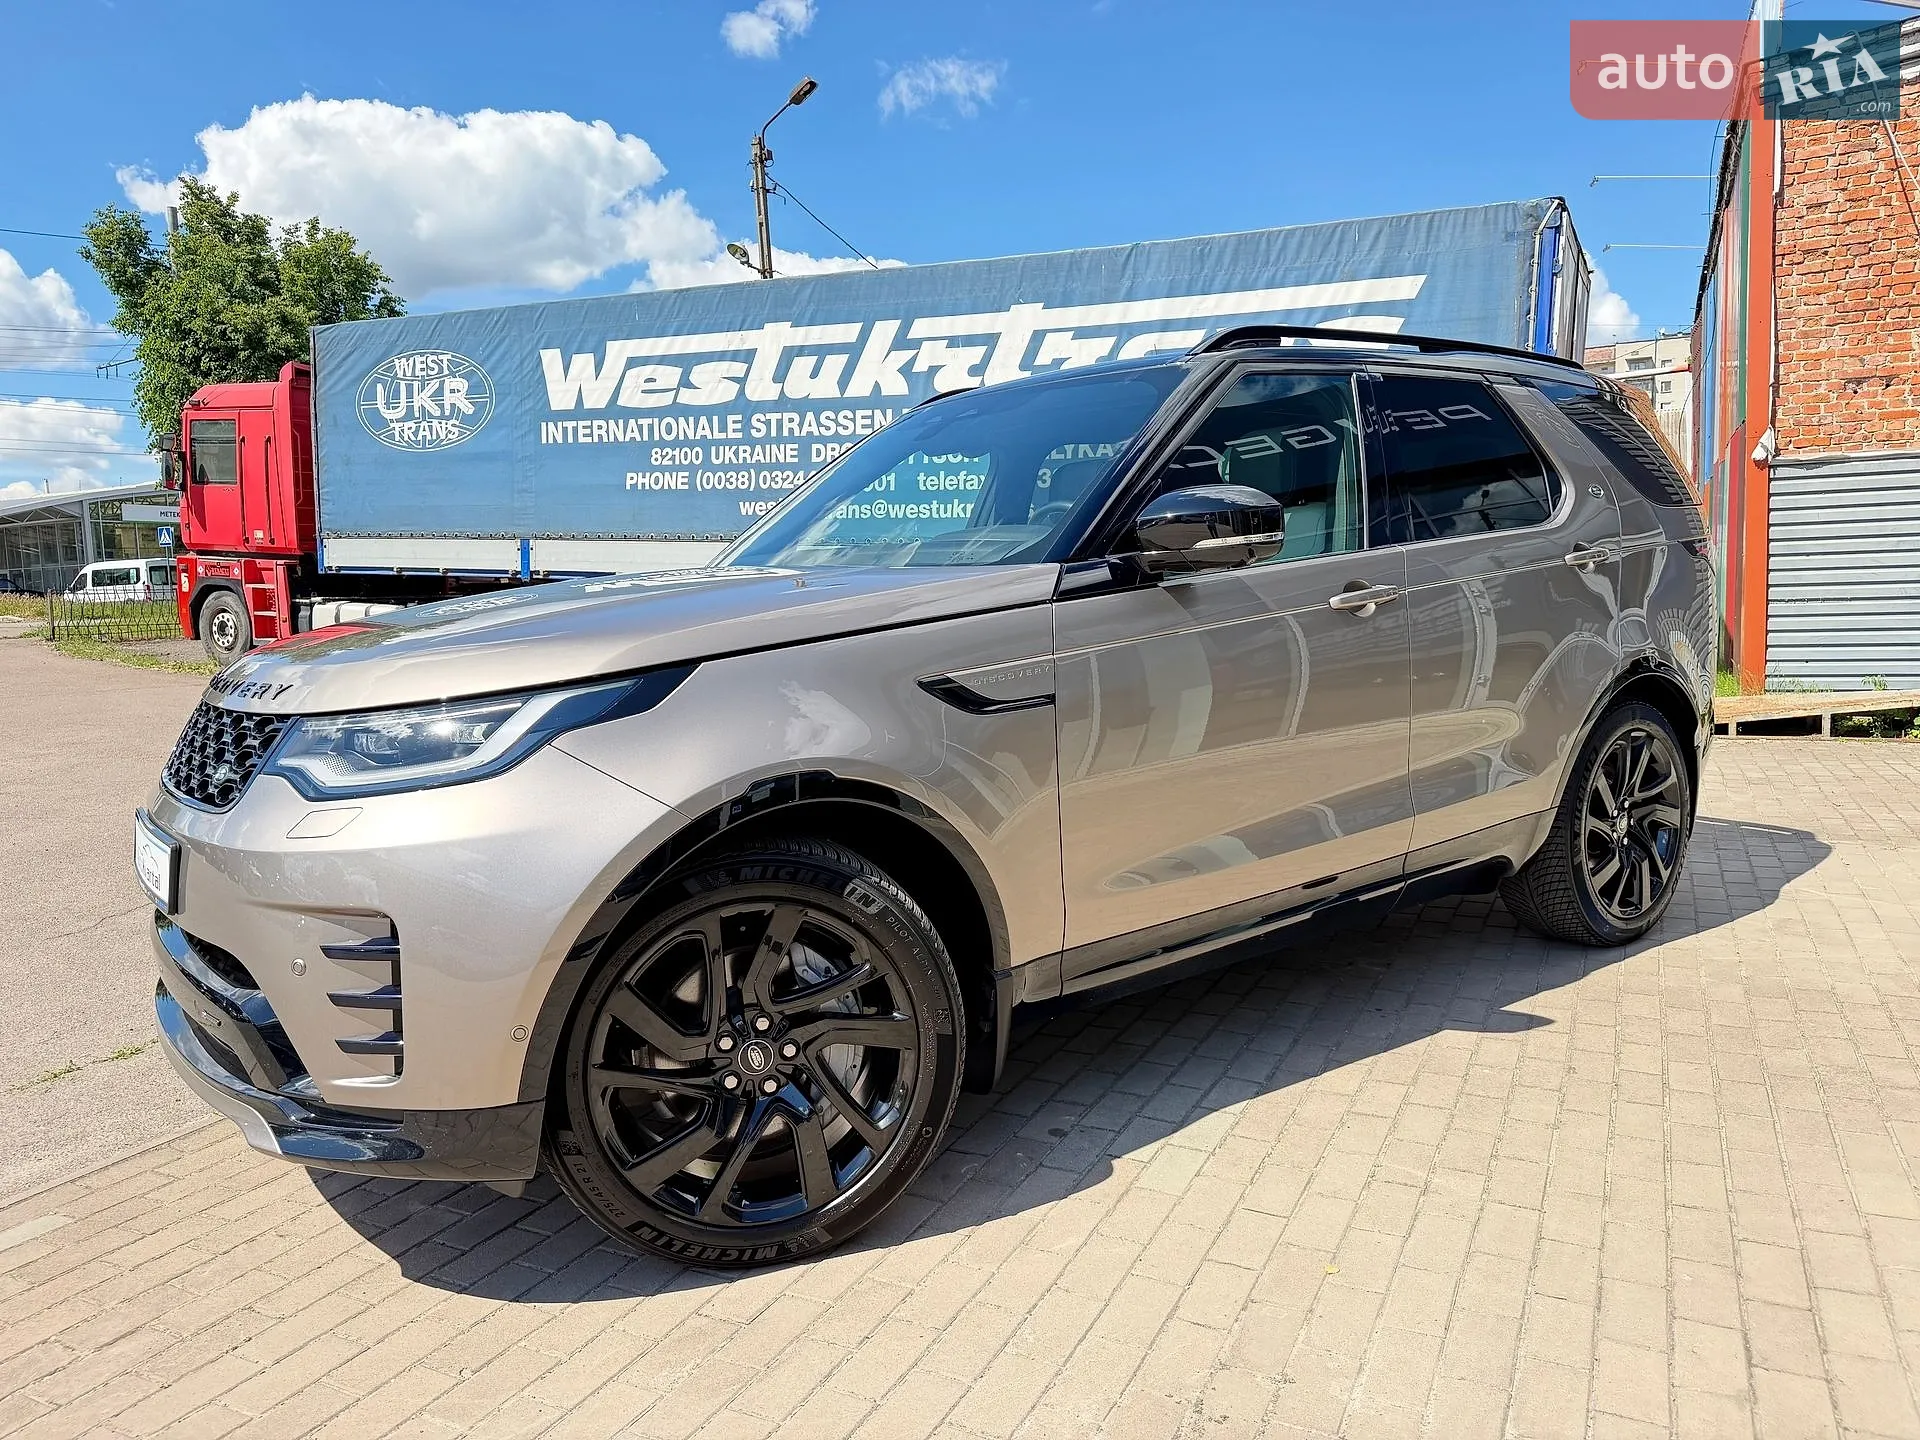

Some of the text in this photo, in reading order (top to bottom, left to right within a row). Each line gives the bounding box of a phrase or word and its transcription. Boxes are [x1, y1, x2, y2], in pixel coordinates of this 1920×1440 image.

[394, 354, 451, 377] WEST
[376, 377, 475, 420] UKR
[390, 421, 460, 442] TRANS
[541, 414, 743, 444] INTERNATIONALE
[650, 446, 703, 466] 82100
[711, 443, 799, 465] UKRAINE
[625, 471, 690, 491] PHONE
[885, 915, 914, 943] PILOT
[633, 1225, 779, 1261] MICHELIN
